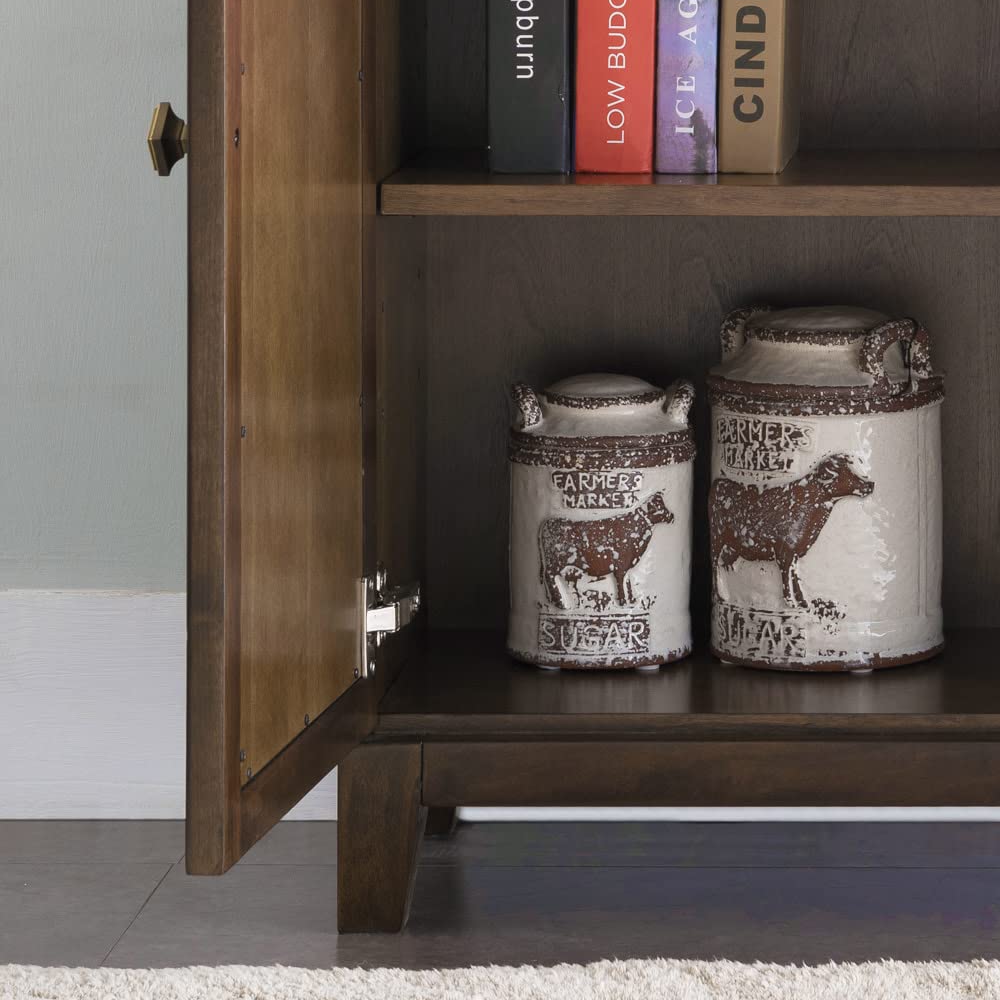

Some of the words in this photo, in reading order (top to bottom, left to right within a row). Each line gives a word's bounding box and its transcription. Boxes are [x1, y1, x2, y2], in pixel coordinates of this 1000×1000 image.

[606, 79, 626, 144] LOW
[675, 76, 696, 135] ICE
[540, 620, 648, 653] SUGAR
[720, 612, 801, 656] SUAR
